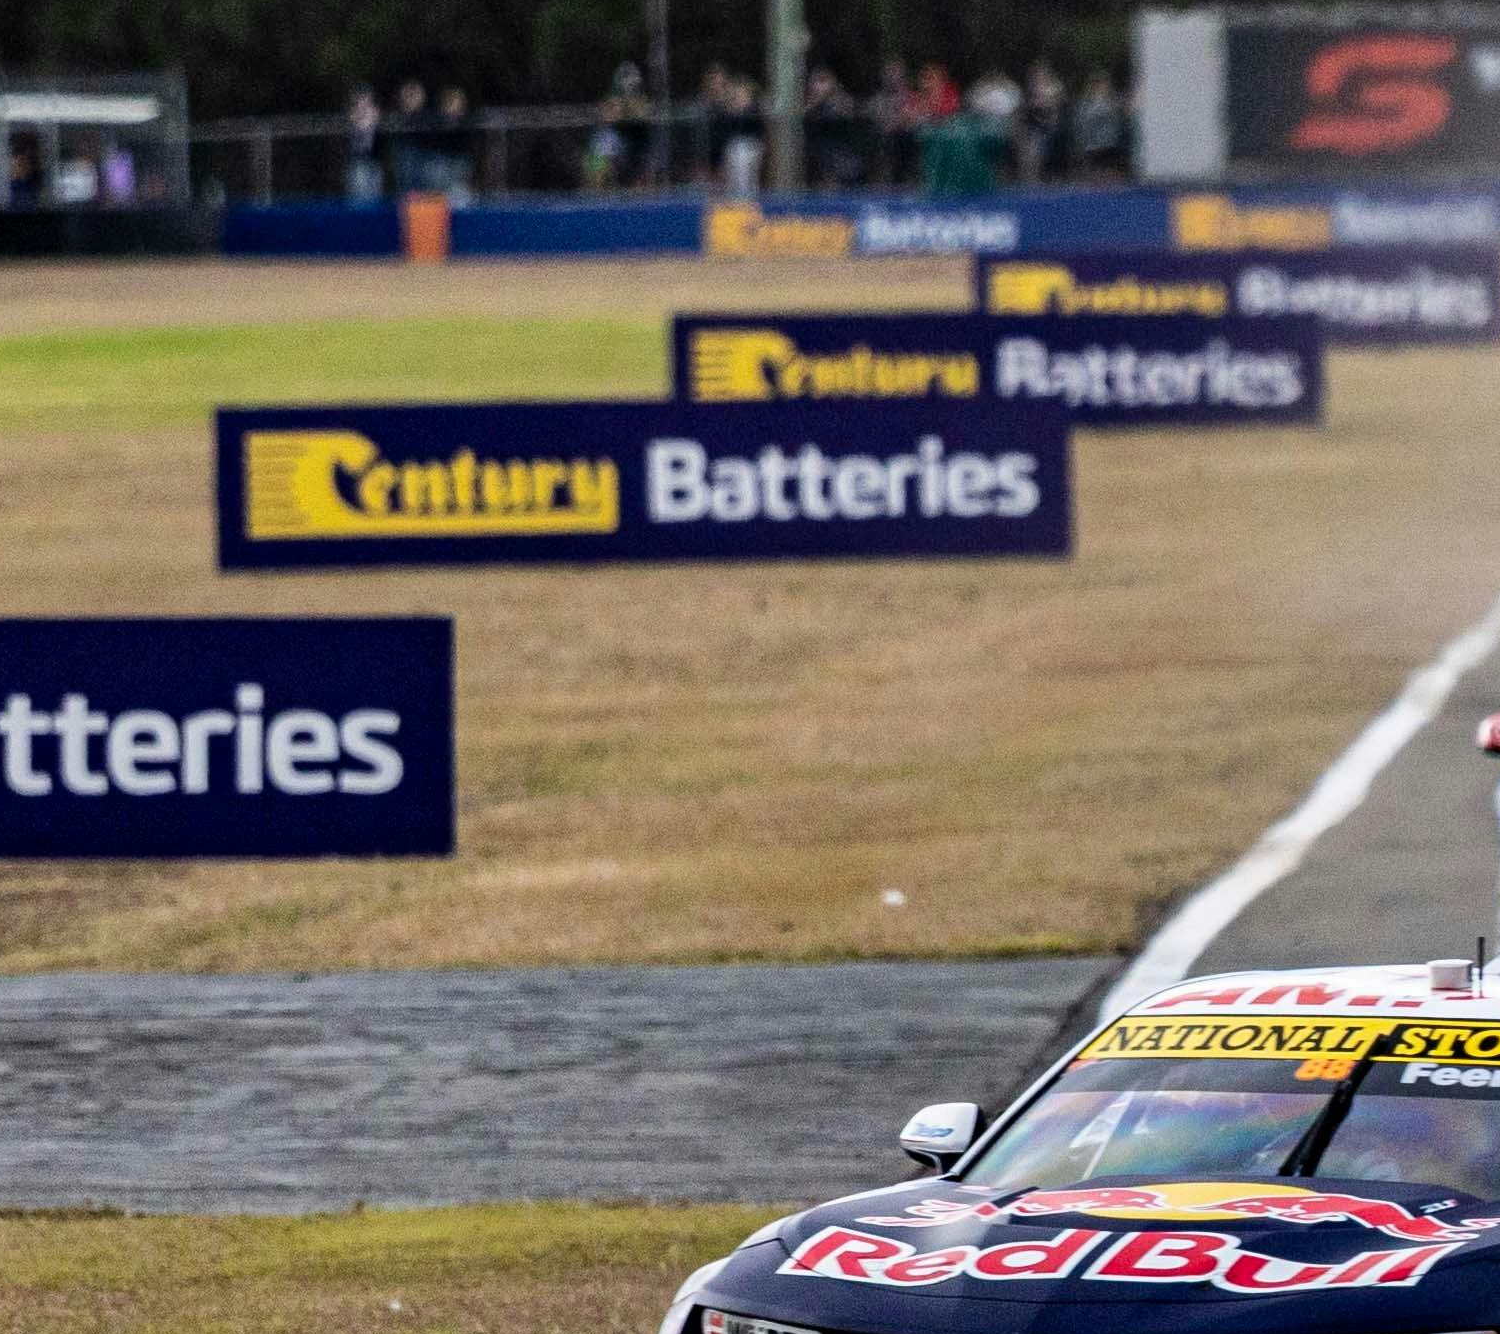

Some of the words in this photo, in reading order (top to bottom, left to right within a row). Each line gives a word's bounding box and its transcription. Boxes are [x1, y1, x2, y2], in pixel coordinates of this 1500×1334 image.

[245, 432, 620, 540] Century
[646, 437, 1041, 525] Batteries
[1099, 1024, 1368, 1058] NATIONAL
[776, 1225, 1088, 1287] Red
[1083, 1231, 1468, 1293] Bull
